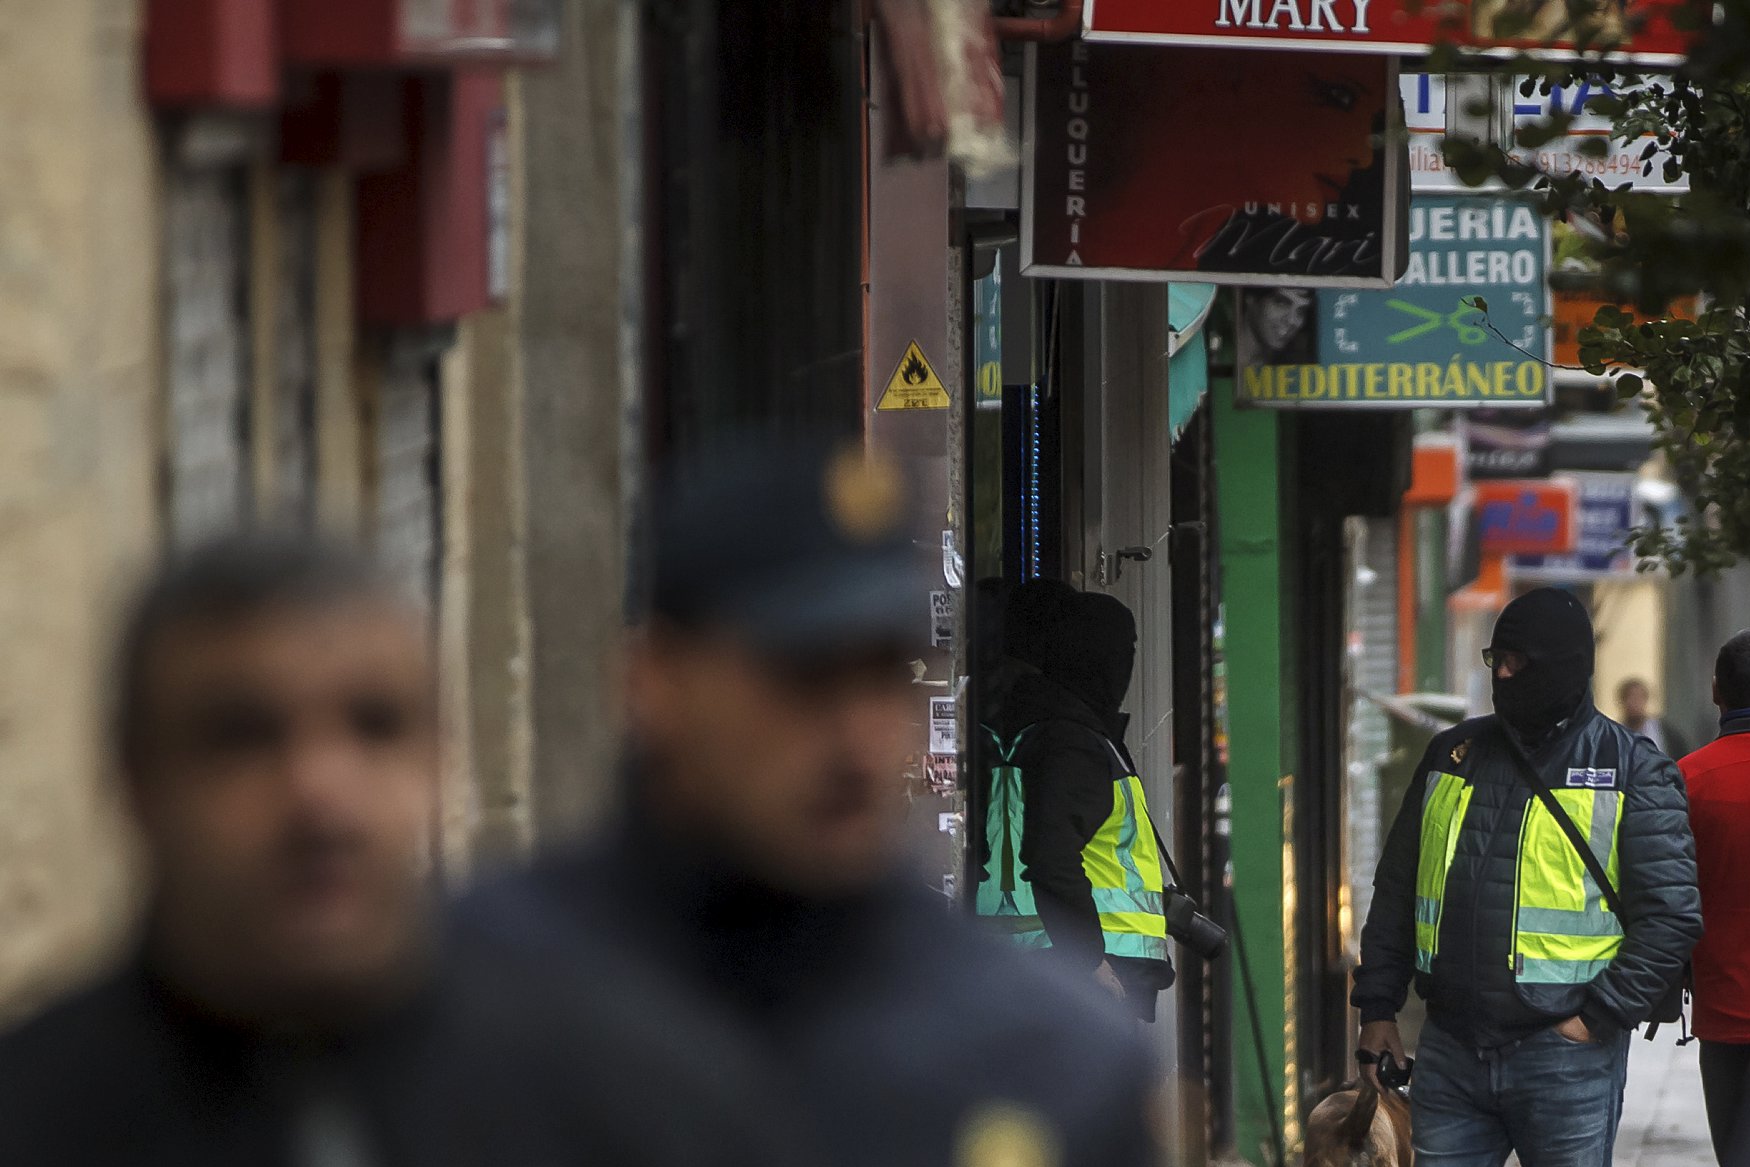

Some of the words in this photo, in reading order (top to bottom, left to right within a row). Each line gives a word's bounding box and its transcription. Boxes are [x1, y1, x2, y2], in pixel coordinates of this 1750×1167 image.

[1215, 0, 1370, 33] MARY
[1244, 200, 1361, 219] UNISEX
[1395, 250, 1536, 284] ALLERO
[1244, 353, 1545, 398] MEDITERRÁNEO
